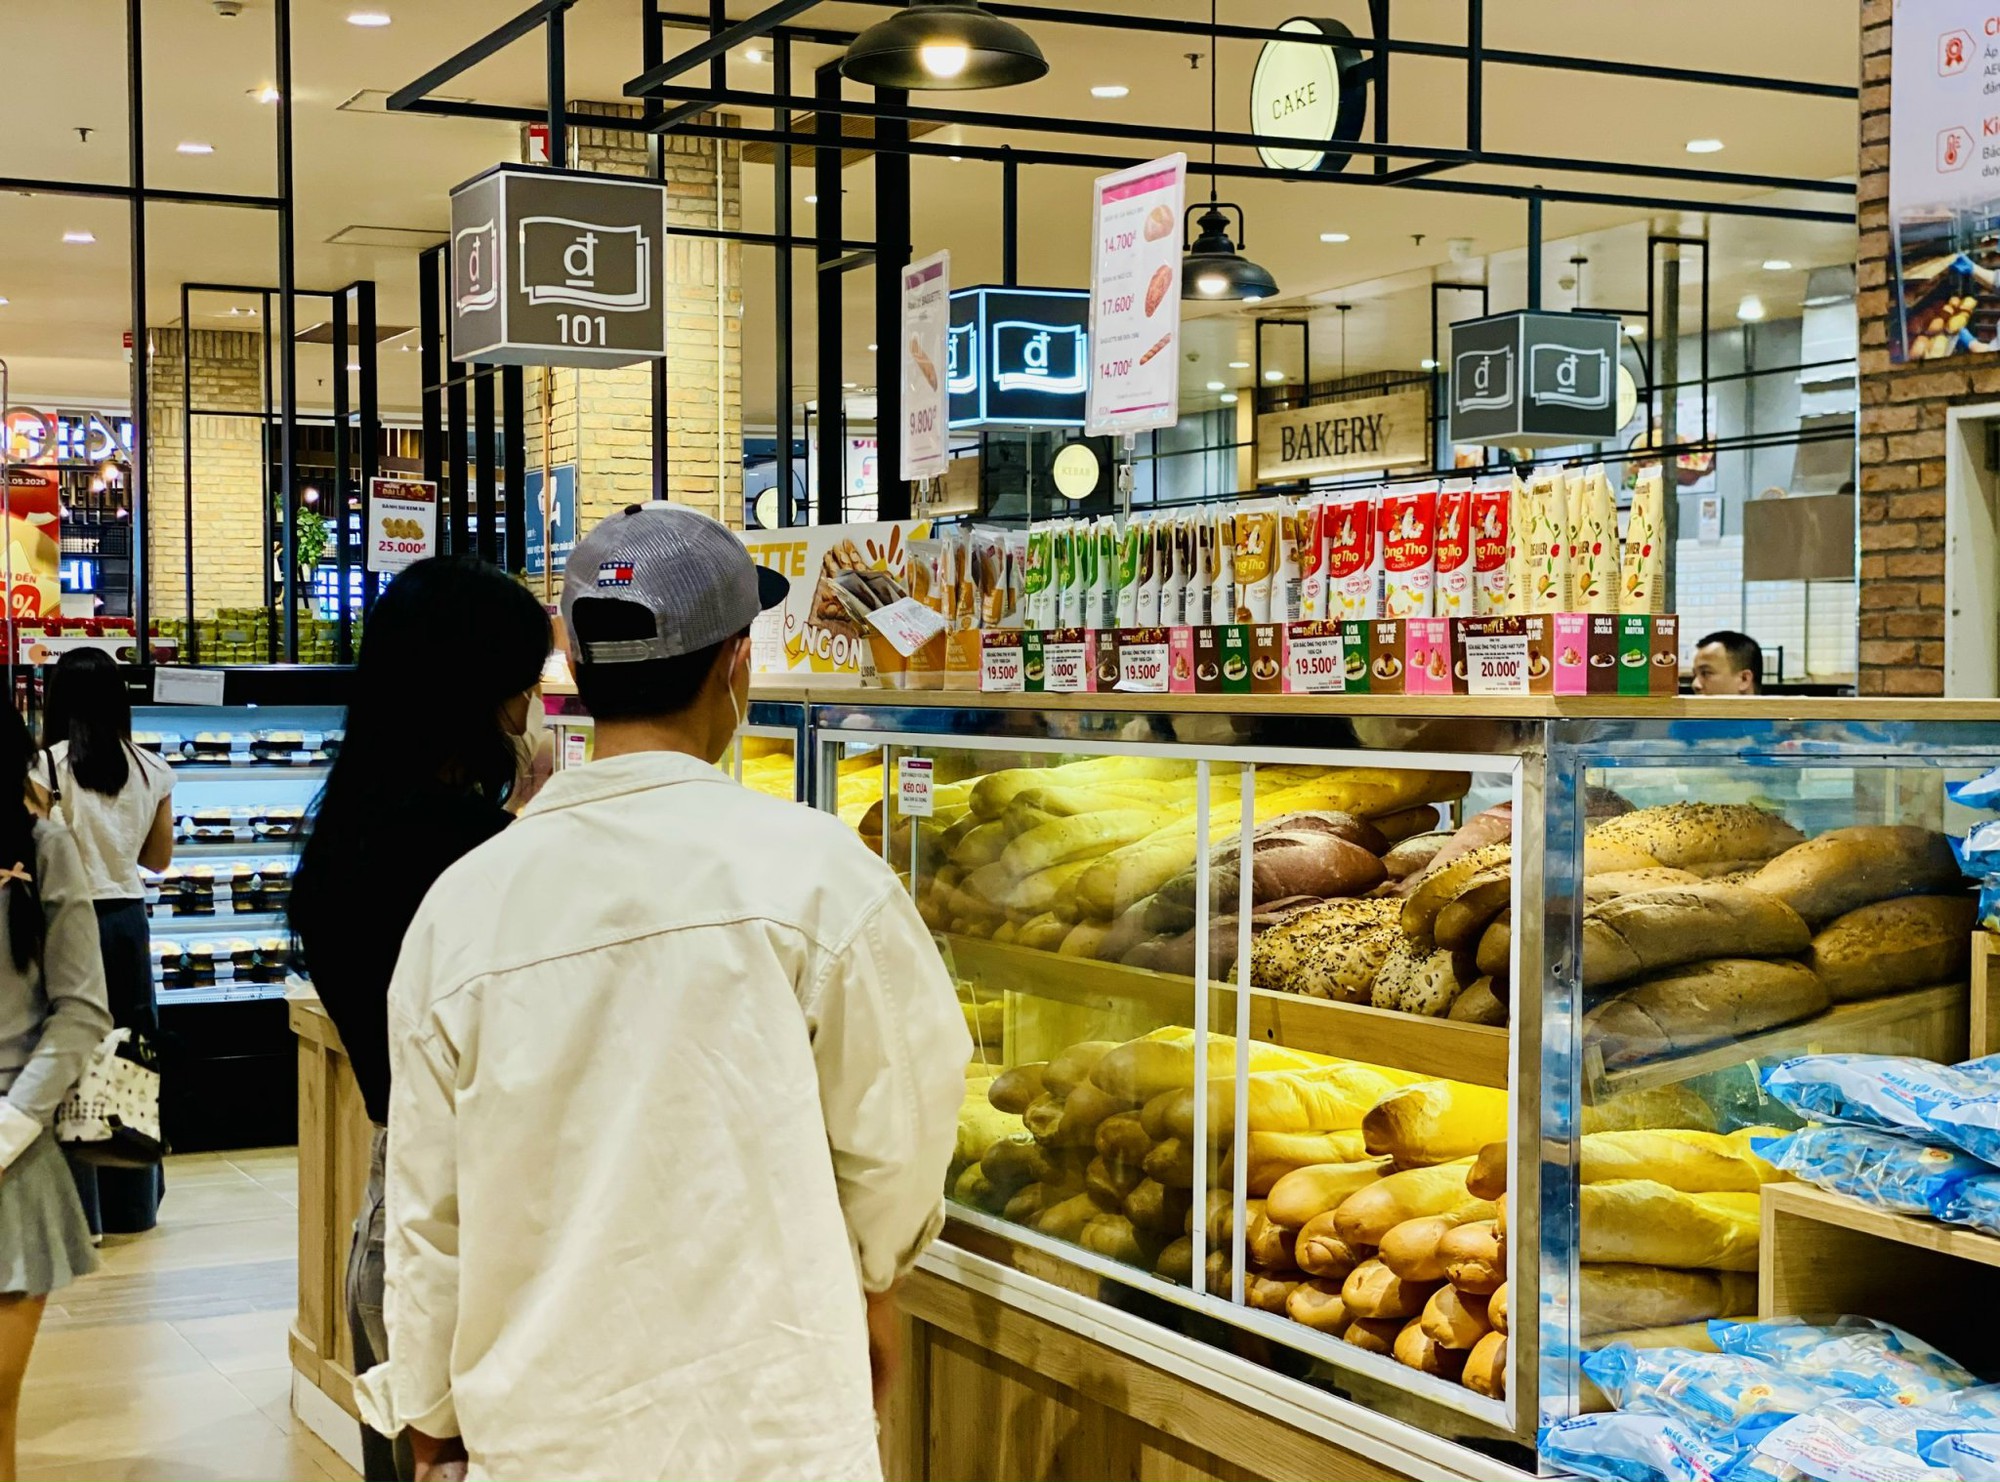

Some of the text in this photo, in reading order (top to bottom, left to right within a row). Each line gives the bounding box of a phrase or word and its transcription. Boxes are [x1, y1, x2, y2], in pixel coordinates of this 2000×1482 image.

[1272, 82, 1317, 120] CAKE
[556, 313, 607, 346] 101
[1281, 412, 1384, 463] BAKERY
[378, 540, 427, 554] 25.000đ
[987, 664, 1018, 680] 19.500đ
[1125, 663, 1161, 680] 19.500đ
[1296, 656, 1337, 675] 19.500đ
[1481, 660, 1520, 678] 20.000đ
